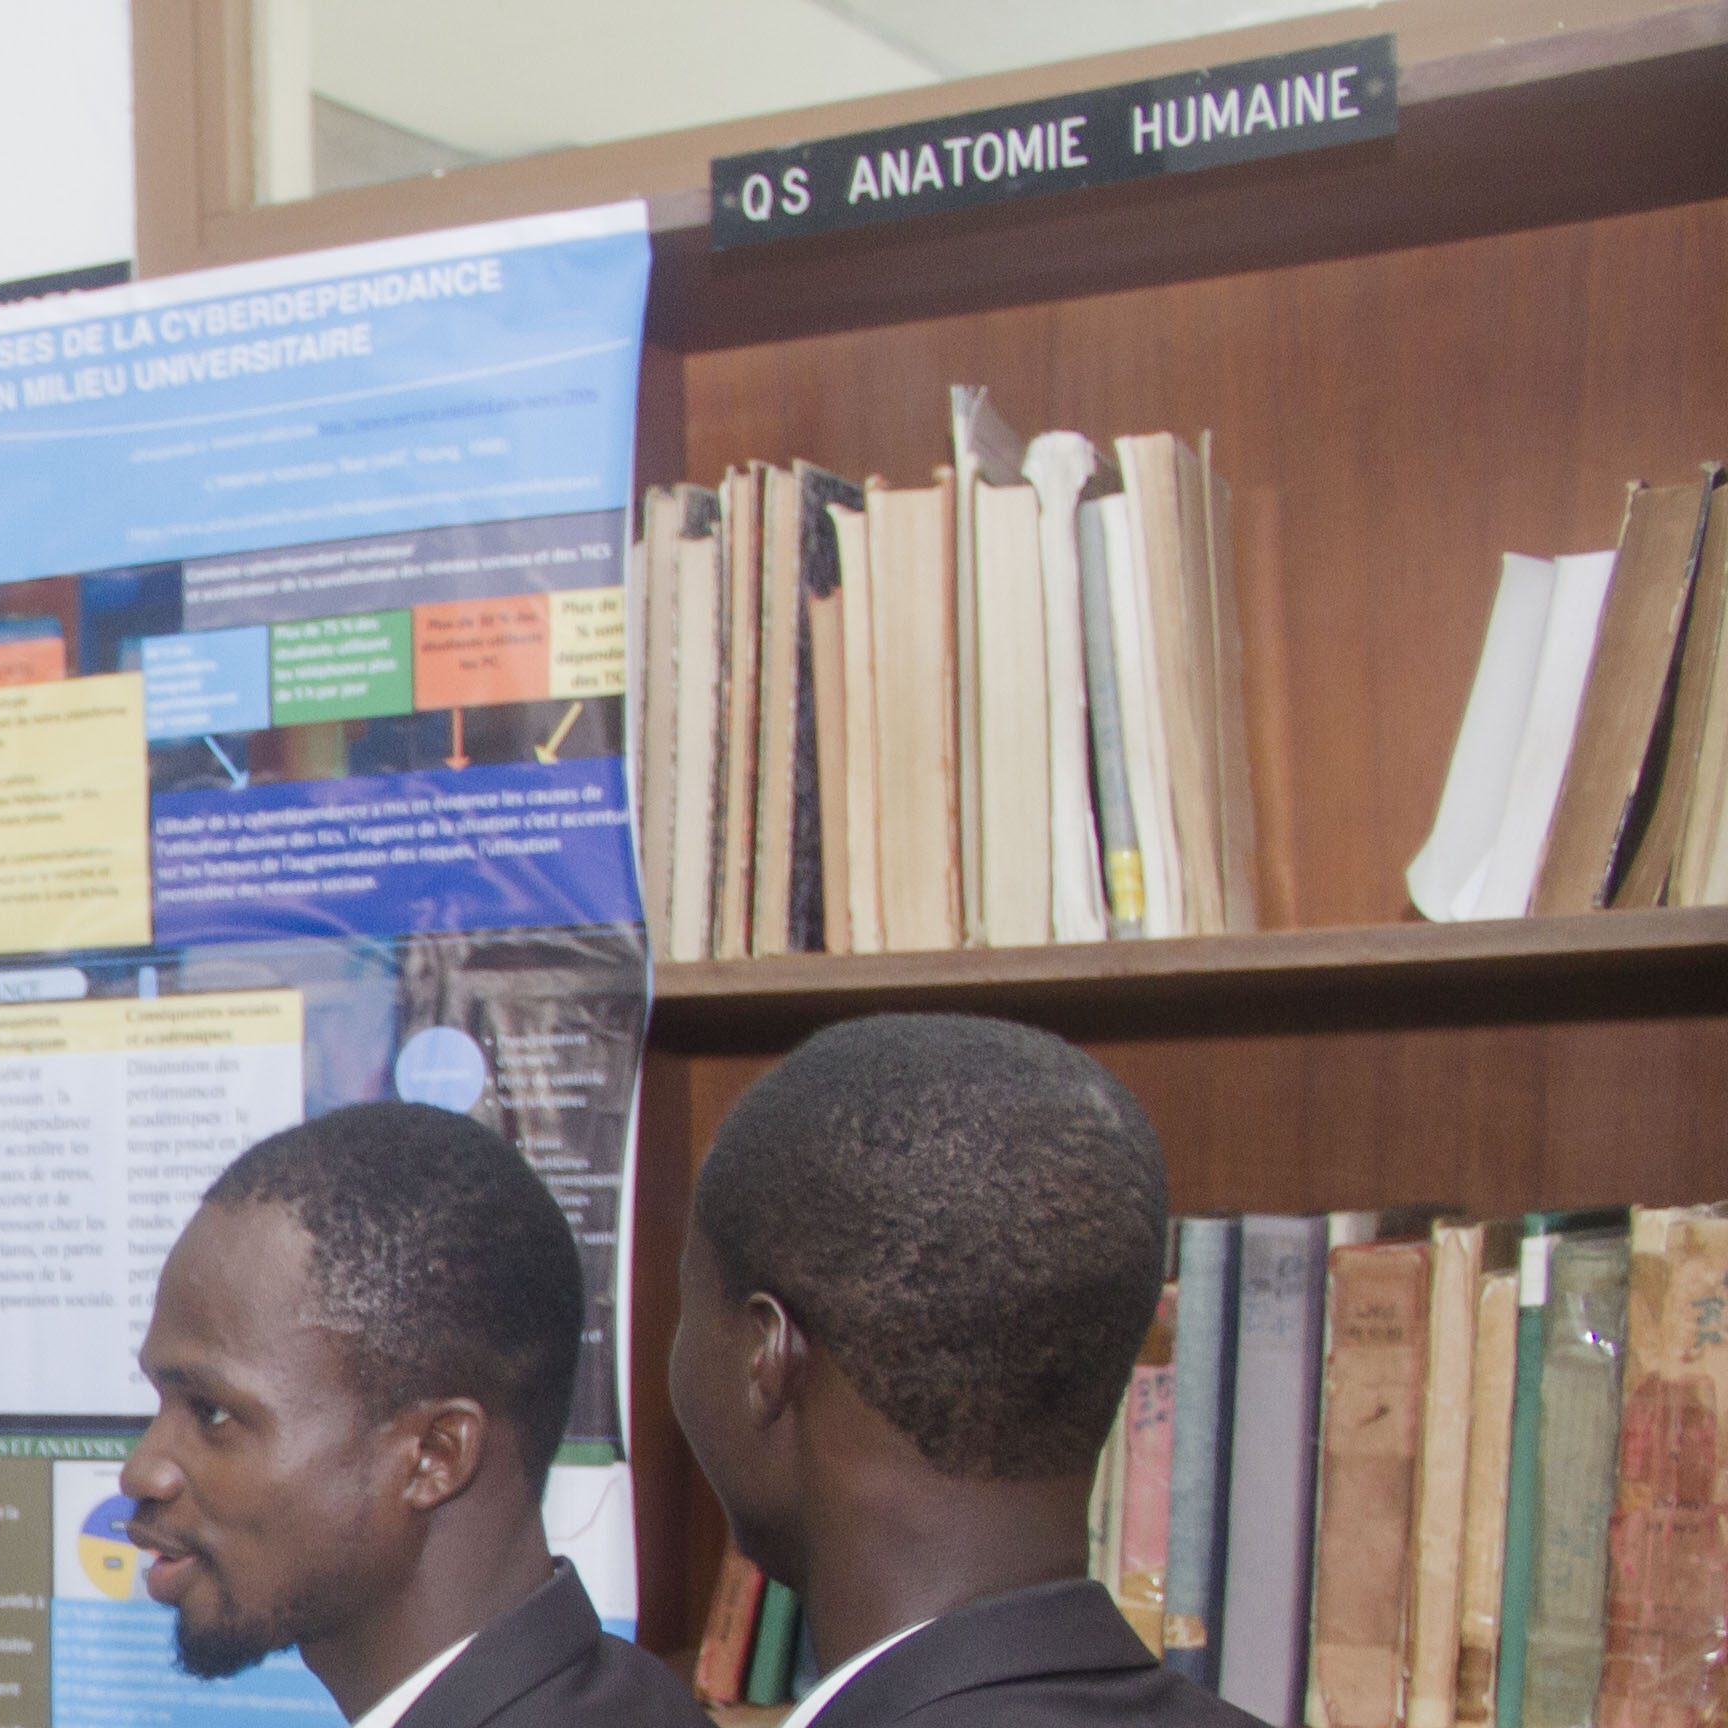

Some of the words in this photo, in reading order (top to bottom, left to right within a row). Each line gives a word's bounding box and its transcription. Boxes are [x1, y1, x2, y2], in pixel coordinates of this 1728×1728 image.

[847, 117, 1089, 205] ANATOMIE
[1132, 68, 1361, 156] HUMAINE
[63, 324, 105, 358] DE
[112, 314, 154, 347] LA
[160, 258, 503, 342] CYBERDEPENDANCE
[23, 362, 127, 409] MILIEU
[133, 323, 372, 392] UNIVERSITAIRE
